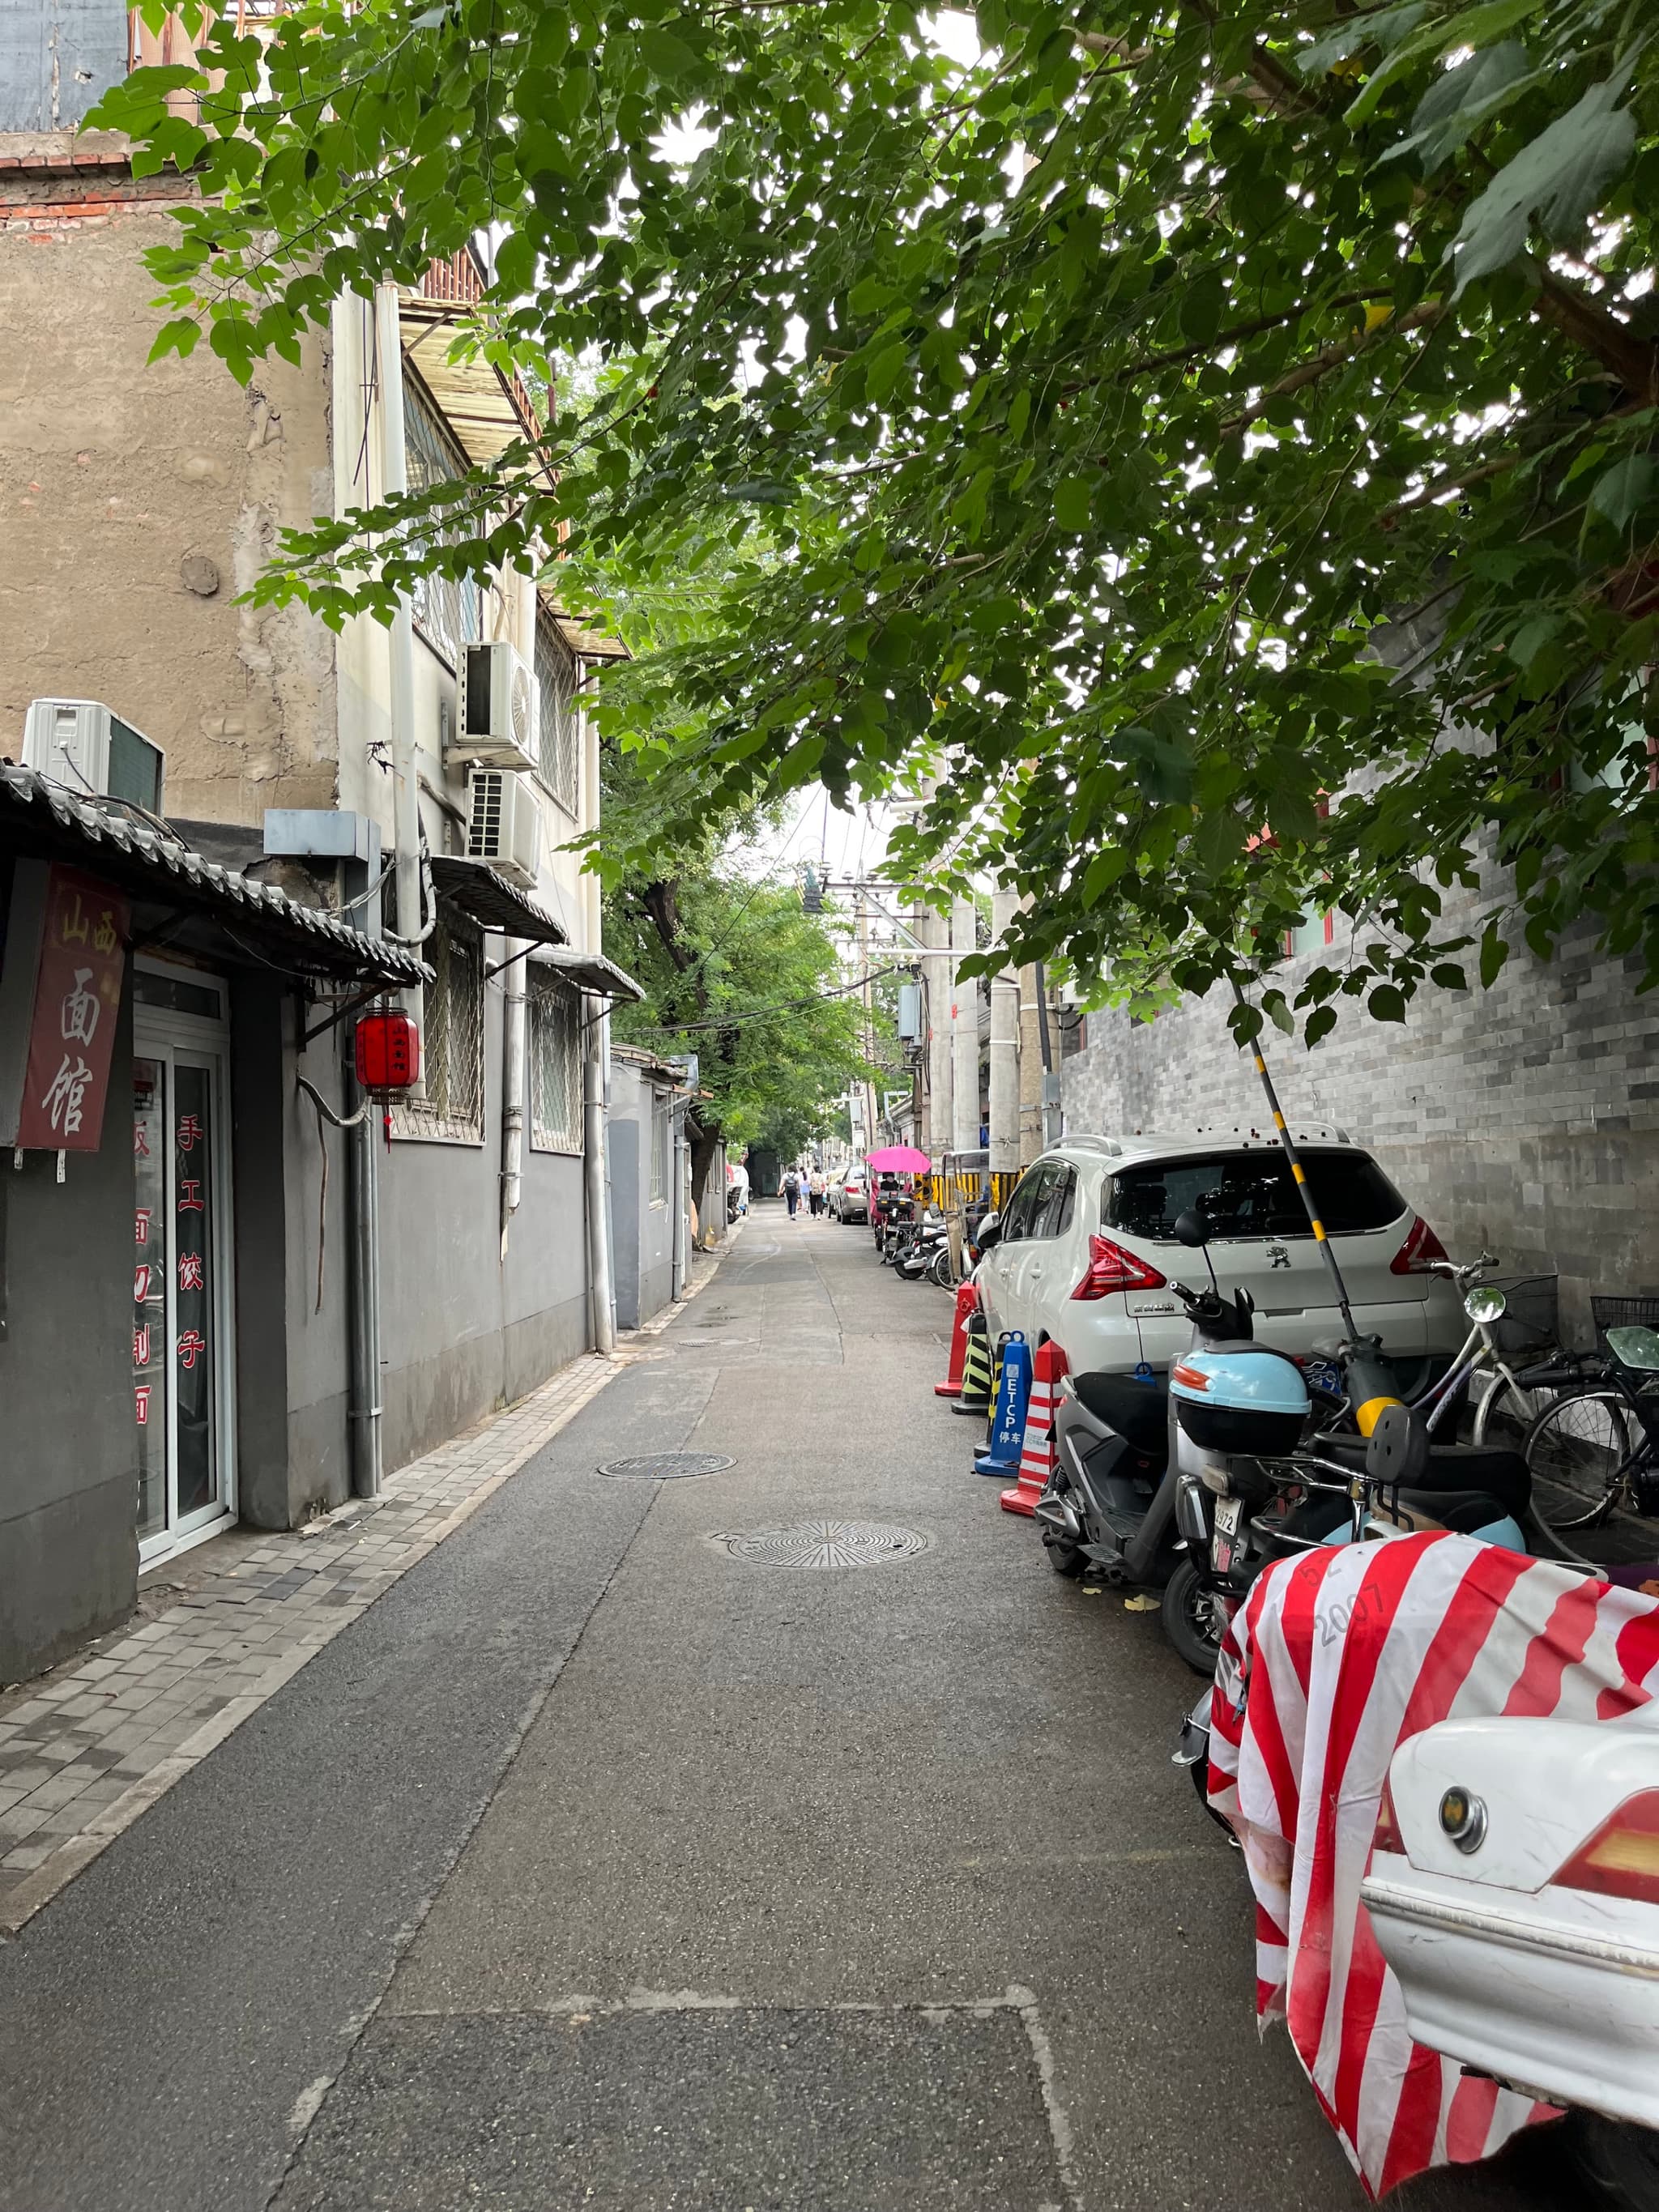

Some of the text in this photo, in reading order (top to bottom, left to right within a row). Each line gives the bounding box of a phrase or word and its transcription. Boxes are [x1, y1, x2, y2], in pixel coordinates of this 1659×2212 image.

[63, 893, 117, 957] 山西
[41, 966, 101, 1138] 面馆
[177, 1114, 206, 1369] 手工饺子
[1004, 1379, 1017, 1430] ETCP
[999, 1430, 1021, 1445] 停车
[1313, 1583, 1384, 1648] 2007
